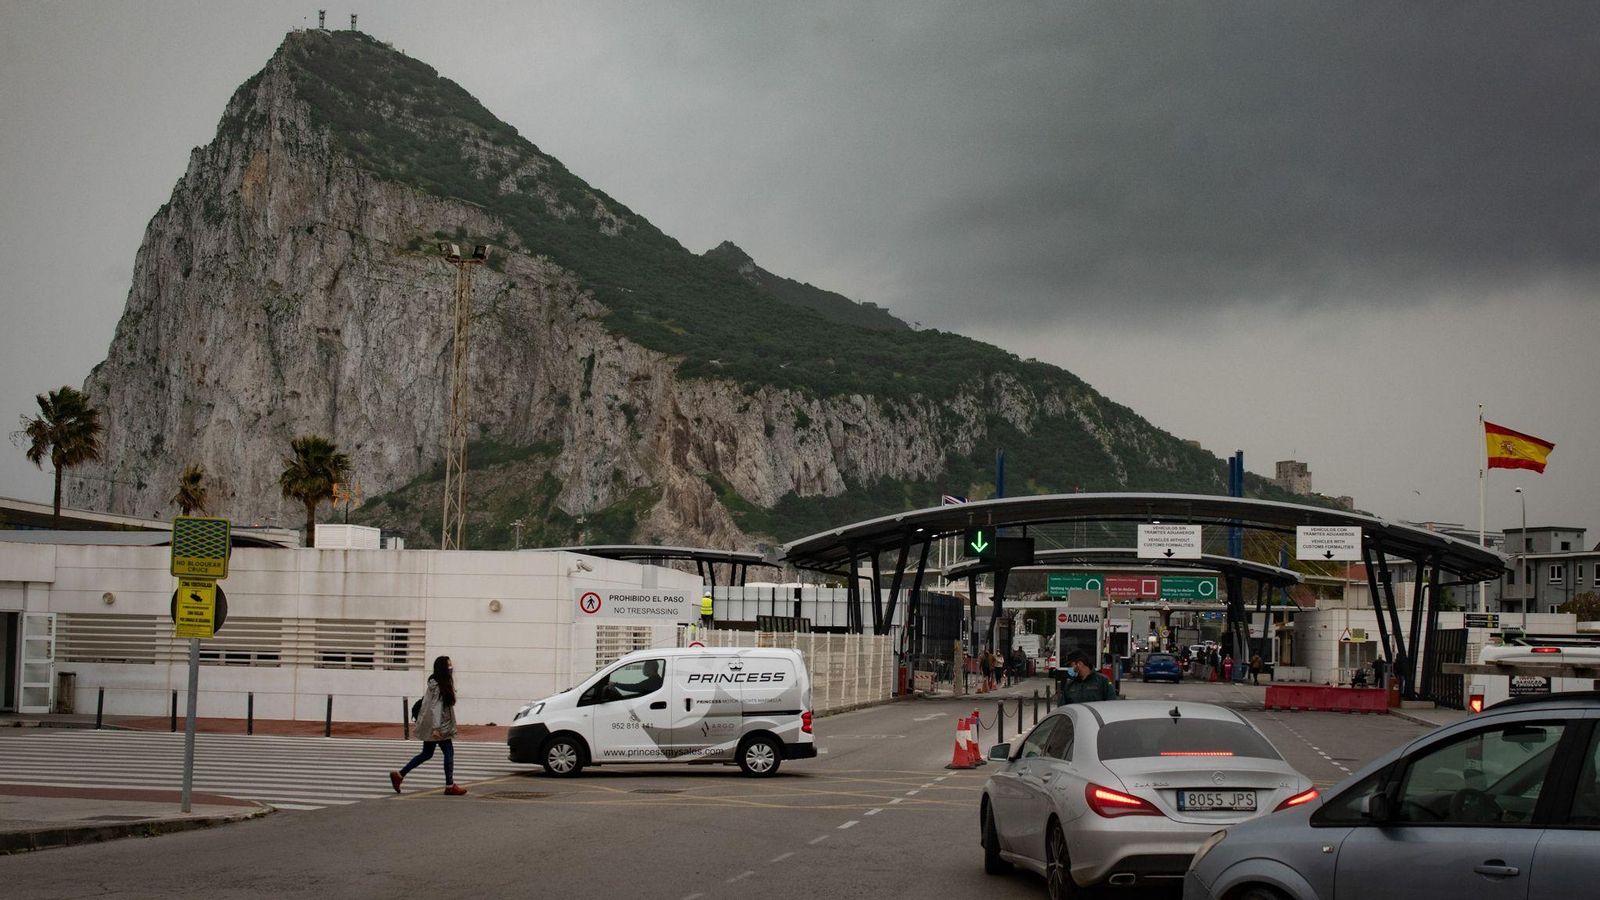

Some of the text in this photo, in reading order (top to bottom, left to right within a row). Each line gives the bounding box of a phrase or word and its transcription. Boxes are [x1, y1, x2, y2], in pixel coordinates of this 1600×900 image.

[609, 594, 651, 602] PROHIBIDO
[663, 595, 684, 603] PASO
[627, 607, 679, 615] TRESPASSING
[1067, 614, 1100, 623] ADUANA
[687, 672, 786, 684] PRINCESS
[603, 747, 724, 758] www.princessmysales.com
[1188, 793, 1254, 806] 8055 JPS
